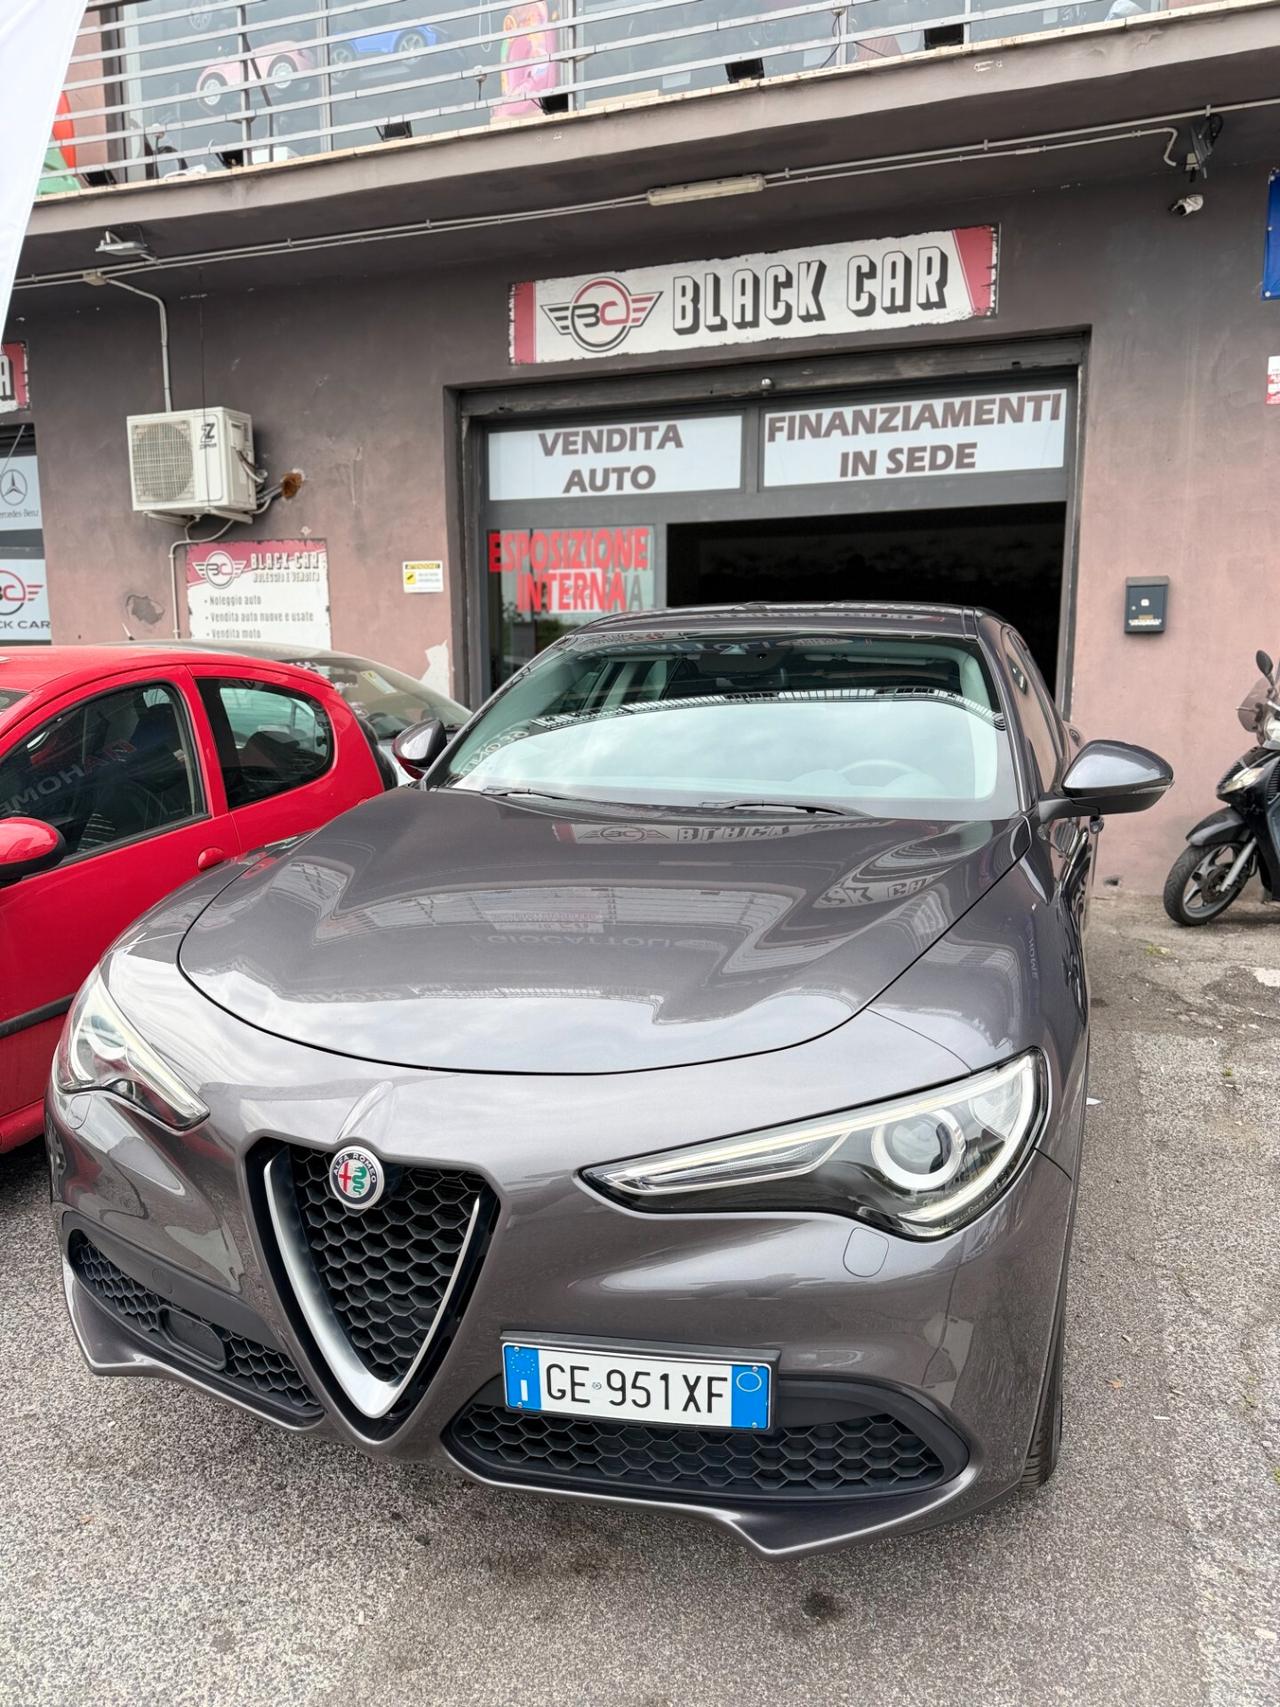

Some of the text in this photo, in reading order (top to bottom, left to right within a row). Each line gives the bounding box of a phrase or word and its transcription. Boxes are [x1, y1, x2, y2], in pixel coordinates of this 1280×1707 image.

[673, 246, 949, 336] BLACK CAR
[768, 393, 1062, 442] FINANZIAMENTI
[538, 424, 684, 457] VENDITA
[840, 442, 977, 478] IN SEDE
[562, 465, 656, 494] AUTO
[250, 551, 320, 570] BLACK CAR
[489, 528, 649, 573] ESPOSIZIONE
[209, 595, 262, 607] Noleggio auto
[516, 571, 627, 614] INTERNA
[17, 620, 50, 629] CAR
[211, 612, 239, 622] Vendita
[241, 612, 258, 622] auto
[211, 628, 261, 639] Vendita moto
[333, 1153, 377, 1183] ALFA ROMEO
[546, 1364, 590, 1404] GE
[606, 1369, 728, 1414] 951XF
